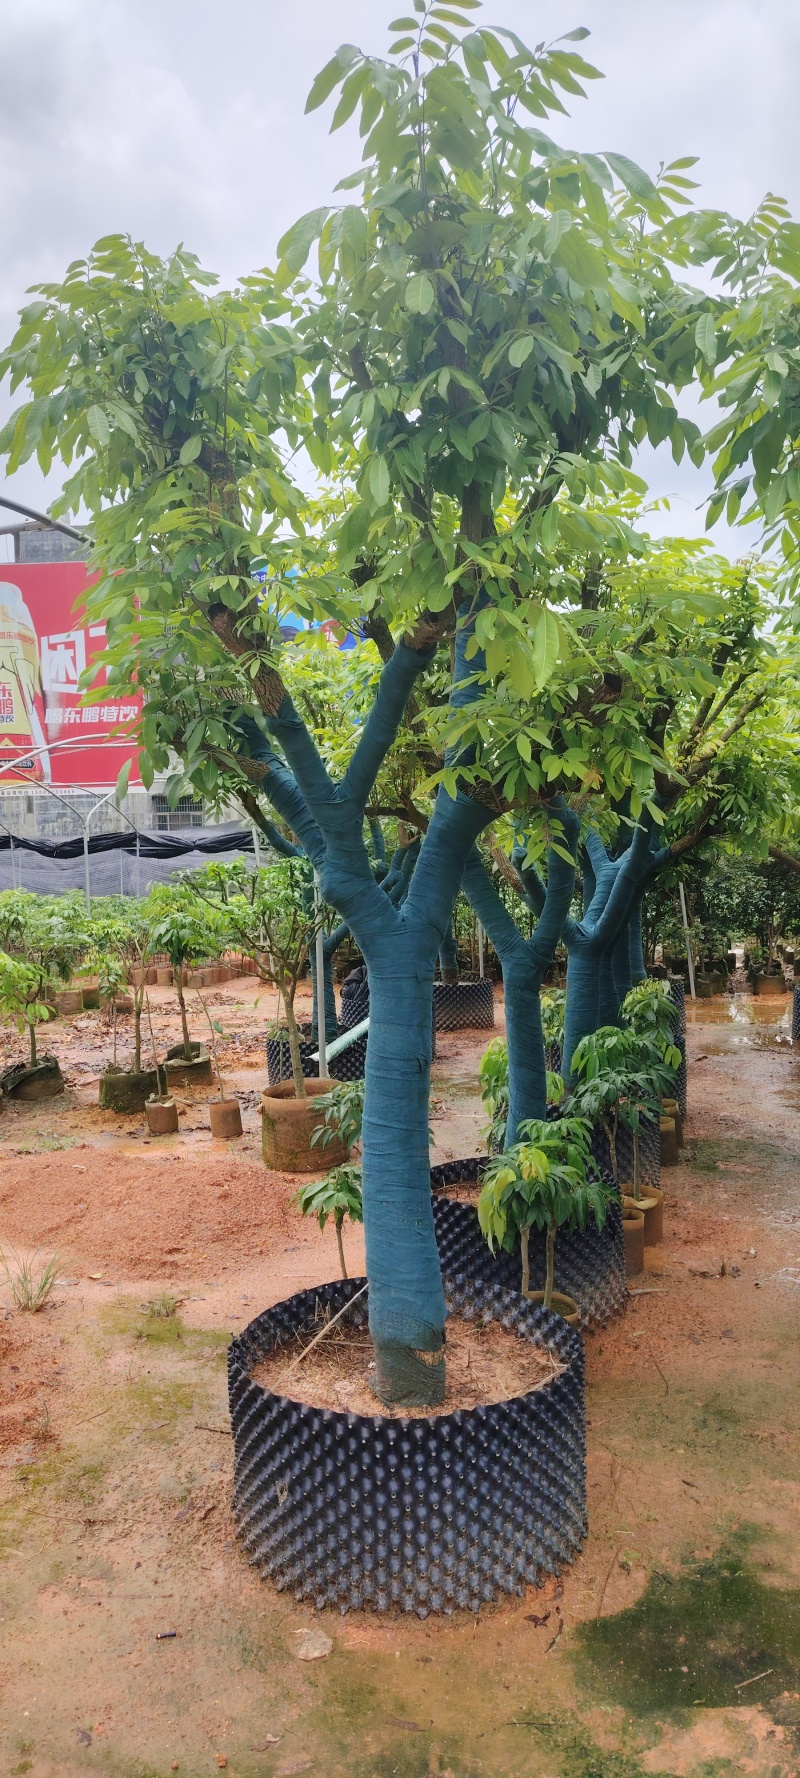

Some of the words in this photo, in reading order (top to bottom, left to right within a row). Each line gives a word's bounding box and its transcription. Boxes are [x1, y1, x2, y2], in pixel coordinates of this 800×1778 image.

[45, 705, 138, 724] 喝东鹏特饮
